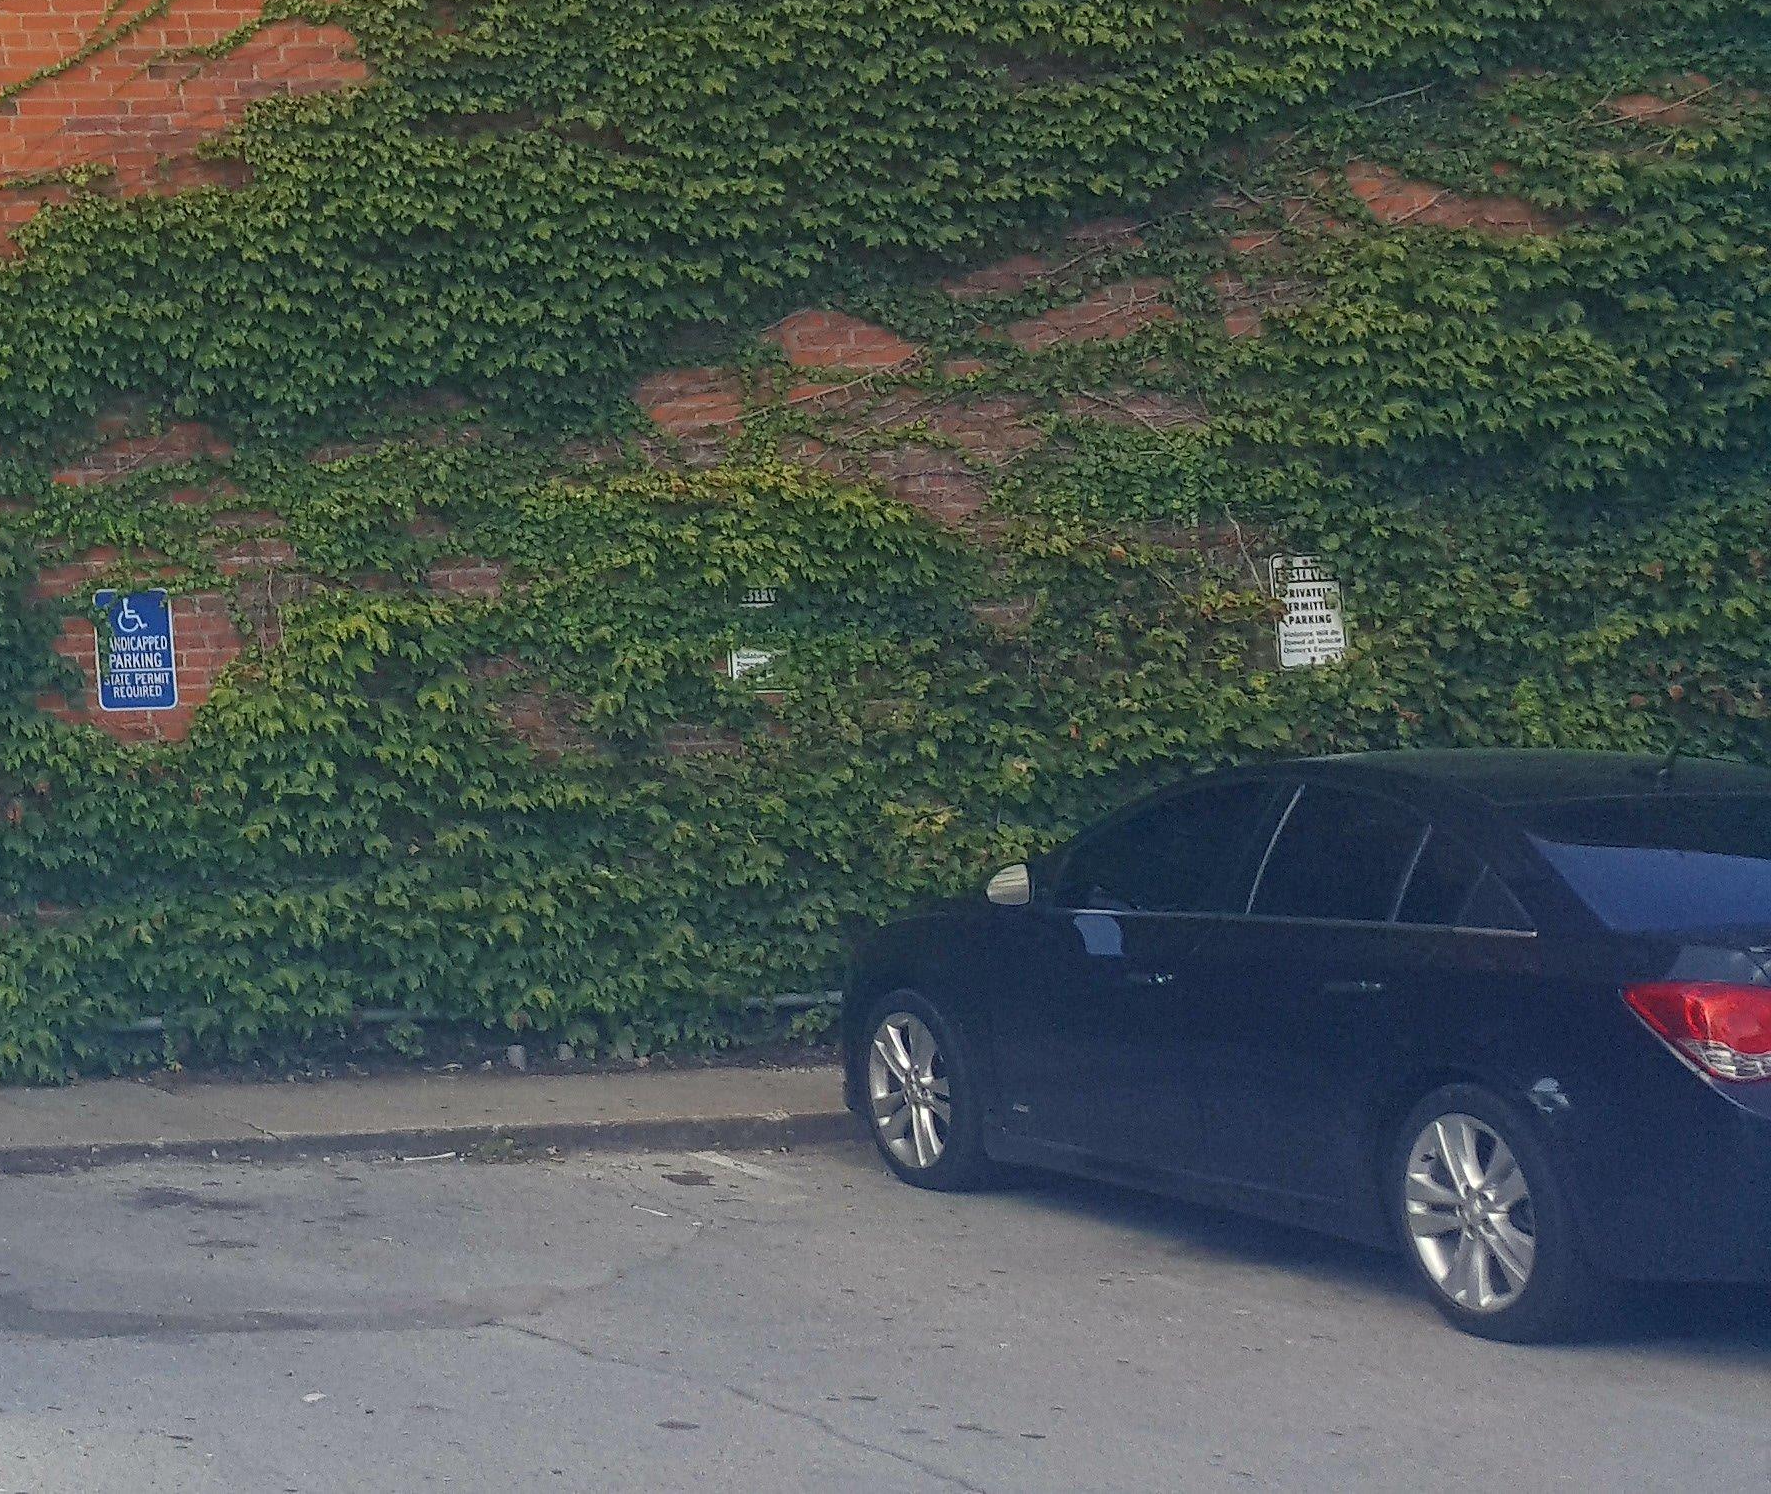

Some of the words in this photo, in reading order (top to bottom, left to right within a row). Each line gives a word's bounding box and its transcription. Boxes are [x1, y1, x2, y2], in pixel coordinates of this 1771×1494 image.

[1288, 614, 1332, 625] PARKING
[110, 636, 167, 652] ANDICAPPED
[109, 653, 162, 668] PARKING
[104, 674, 131, 686] STATE
[135, 673, 169, 685] PERMIT
[114, 686, 163, 699] REQUIRED
